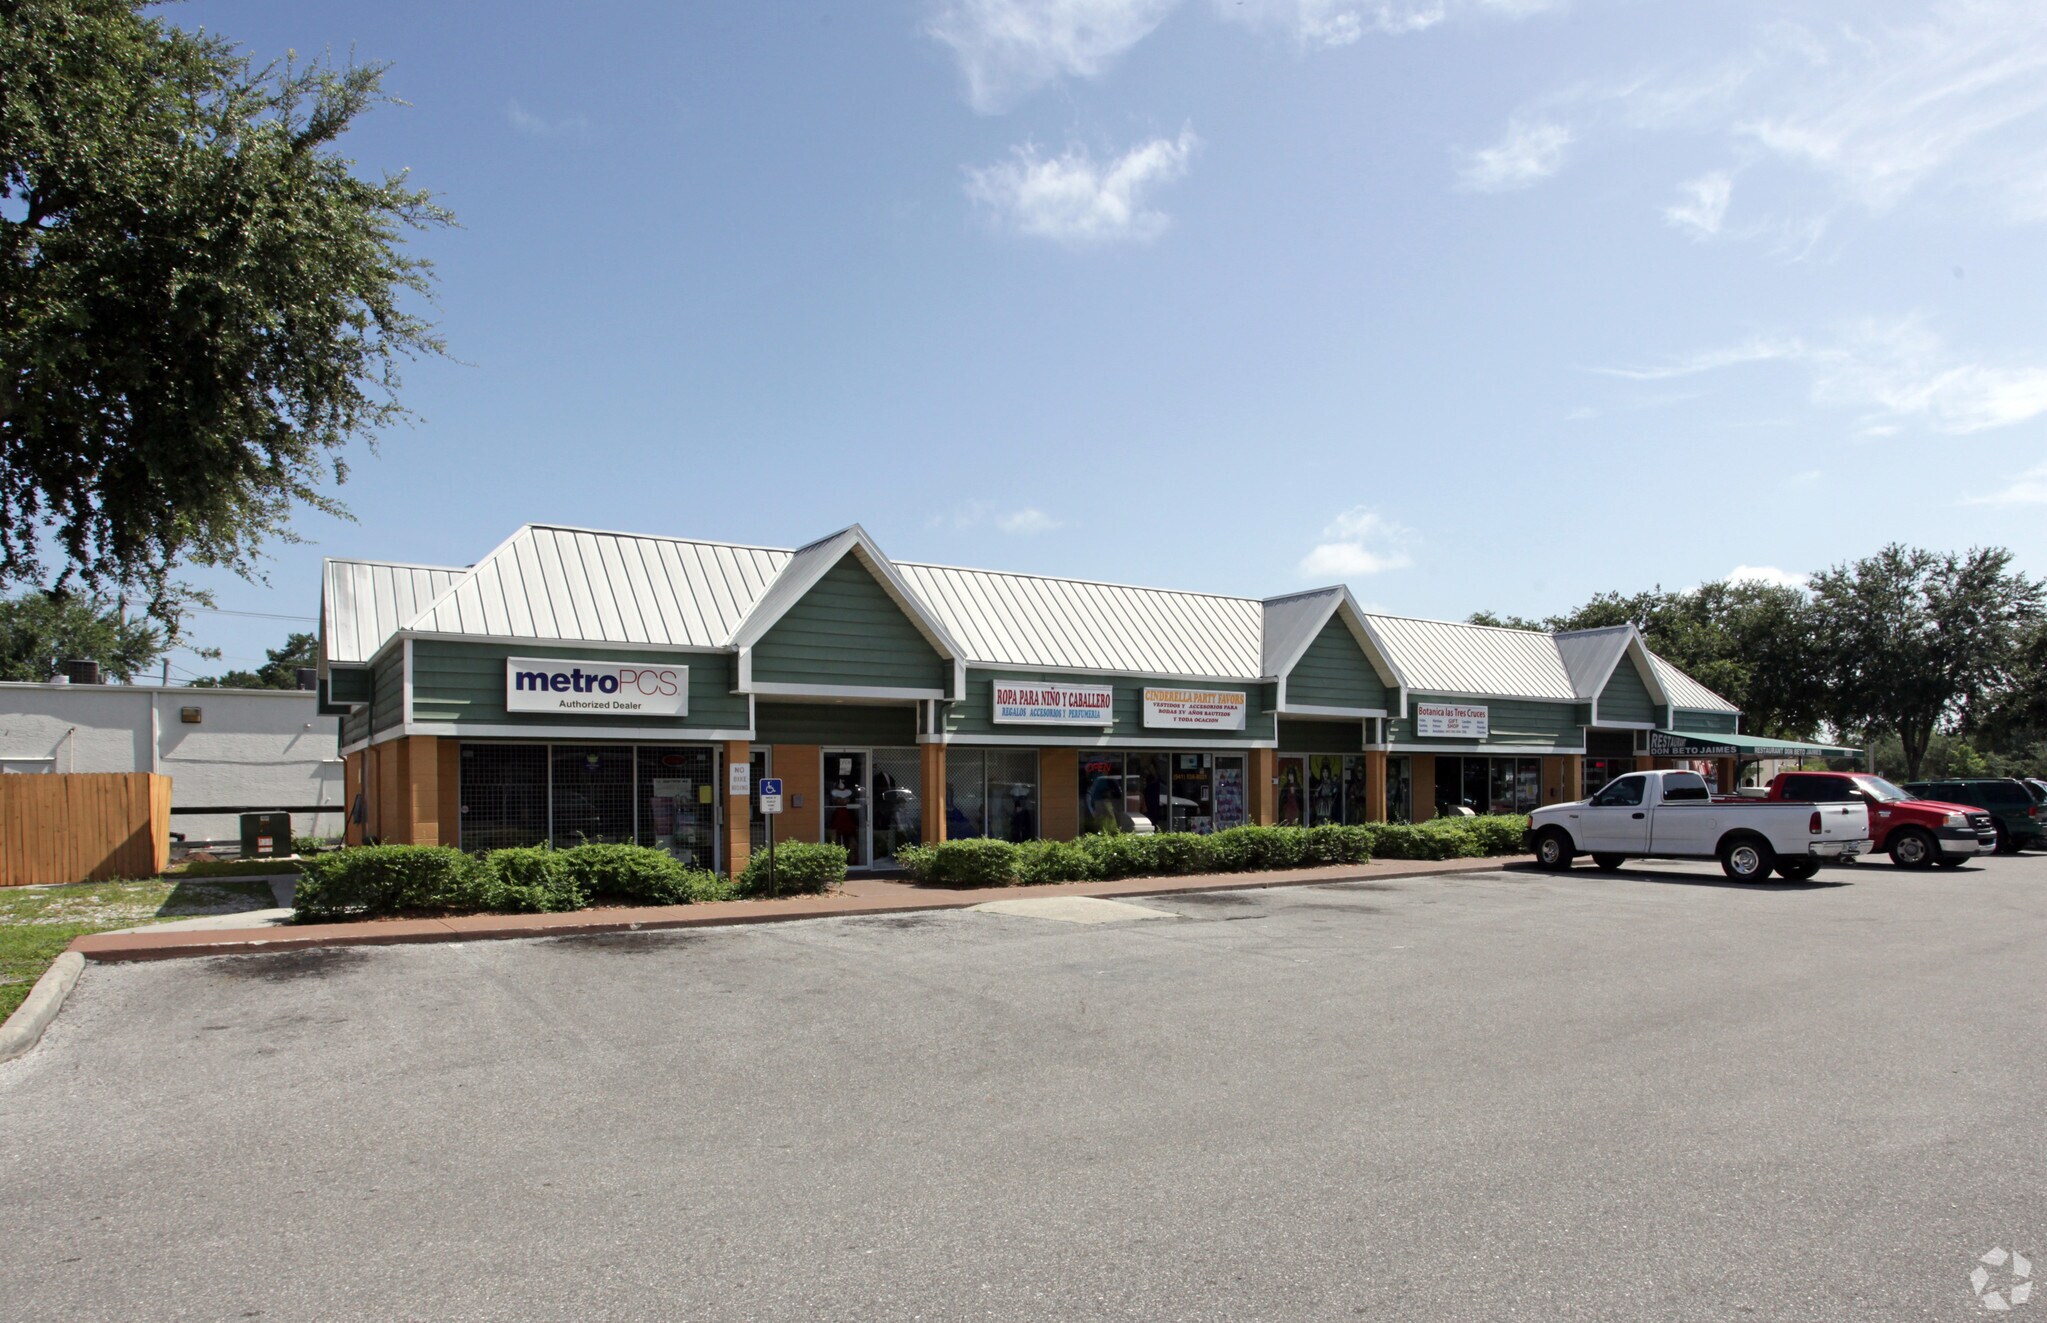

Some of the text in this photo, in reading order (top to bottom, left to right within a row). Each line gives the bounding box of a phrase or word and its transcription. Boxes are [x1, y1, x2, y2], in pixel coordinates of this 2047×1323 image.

[516, 669, 678, 696] metroPCS
[997, 687, 1110, 708] ROPA PARA NIÑO Y CABALLERO
[1145, 690, 1244, 705] CINDERELLA PARTY FAVORS
[559, 700, 642, 710] Authorized Dealer
[1002, 707, 1100, 718] REGALOS ACCESORIOS Y PERFUMERIA
[1419, 707, 1486, 718] Botanica las Tres Cruces
[1700, 746, 1737, 754] JAIMES
[1754, 746, 1784, 754] RESTAURANT
